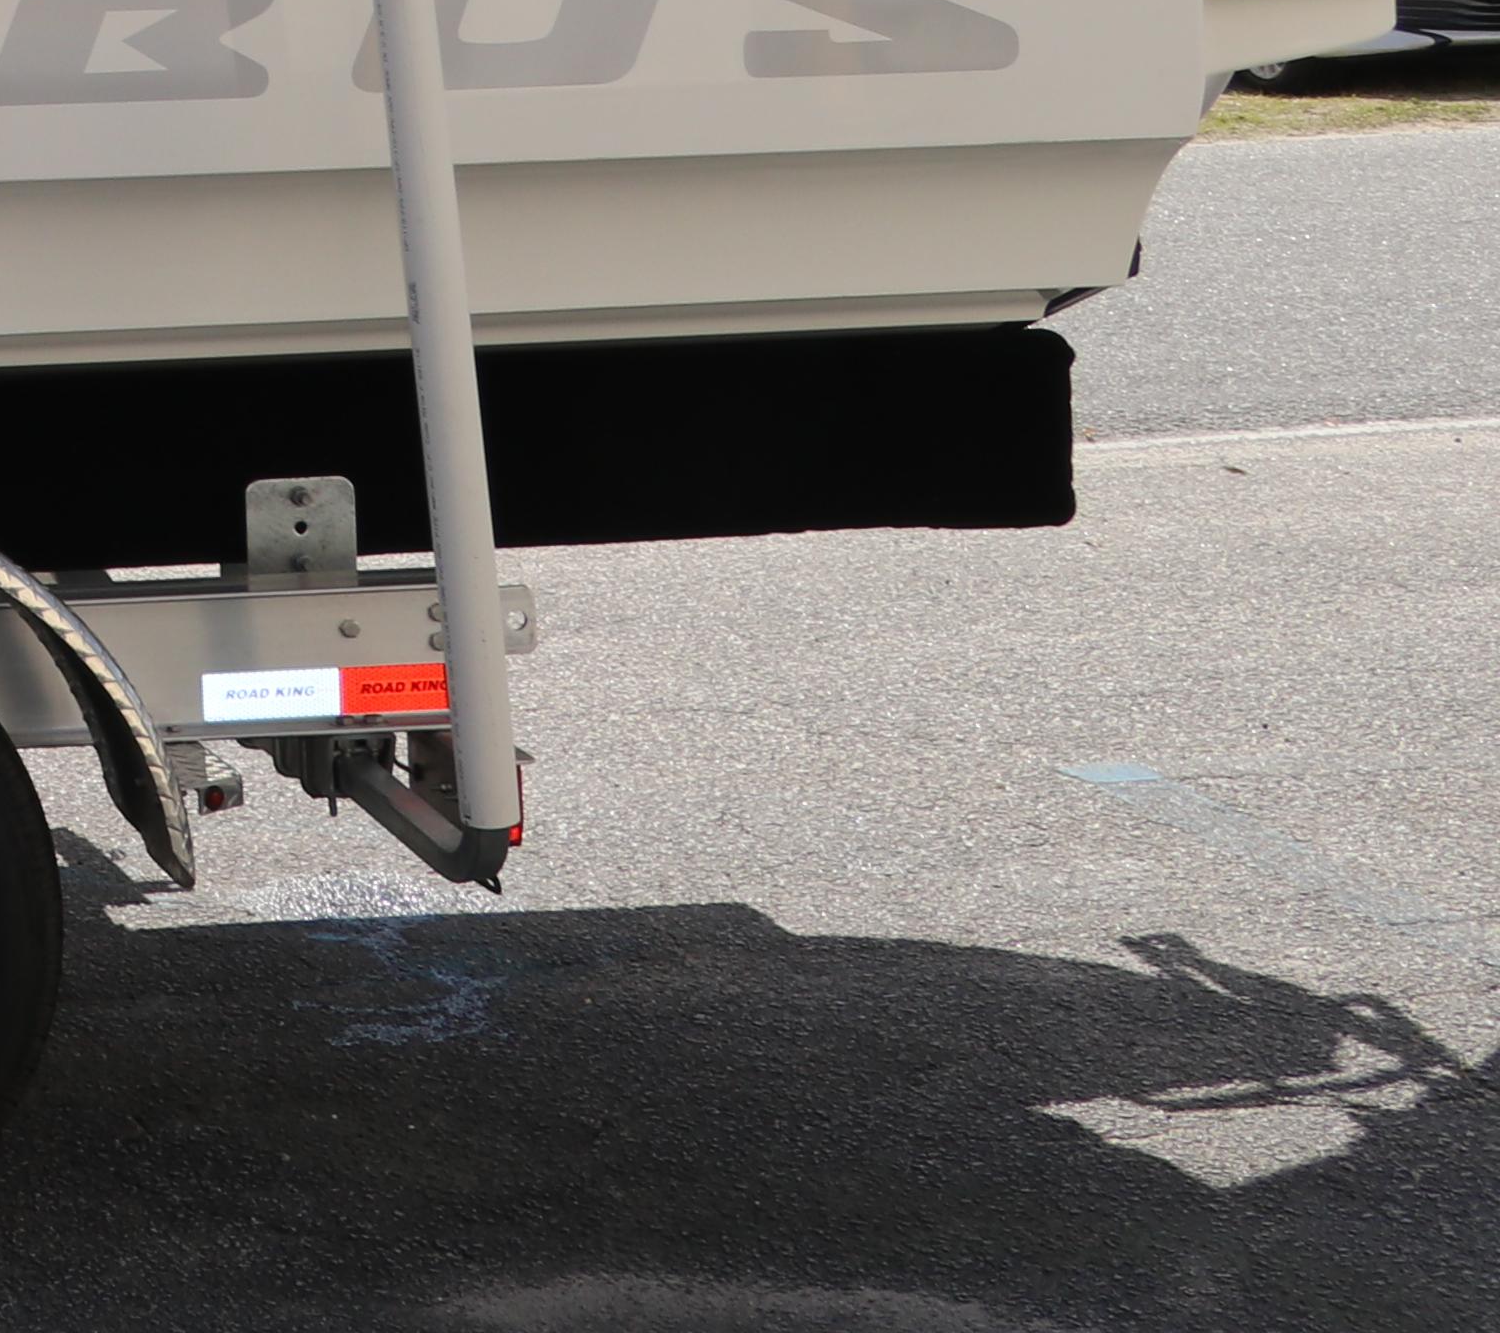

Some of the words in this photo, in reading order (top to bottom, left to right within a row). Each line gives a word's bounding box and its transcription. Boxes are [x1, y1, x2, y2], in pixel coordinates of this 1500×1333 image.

[225, 688, 269, 700] ROAD
[275, 685, 315, 697] KING
[360, 682, 405, 695] ROAD
